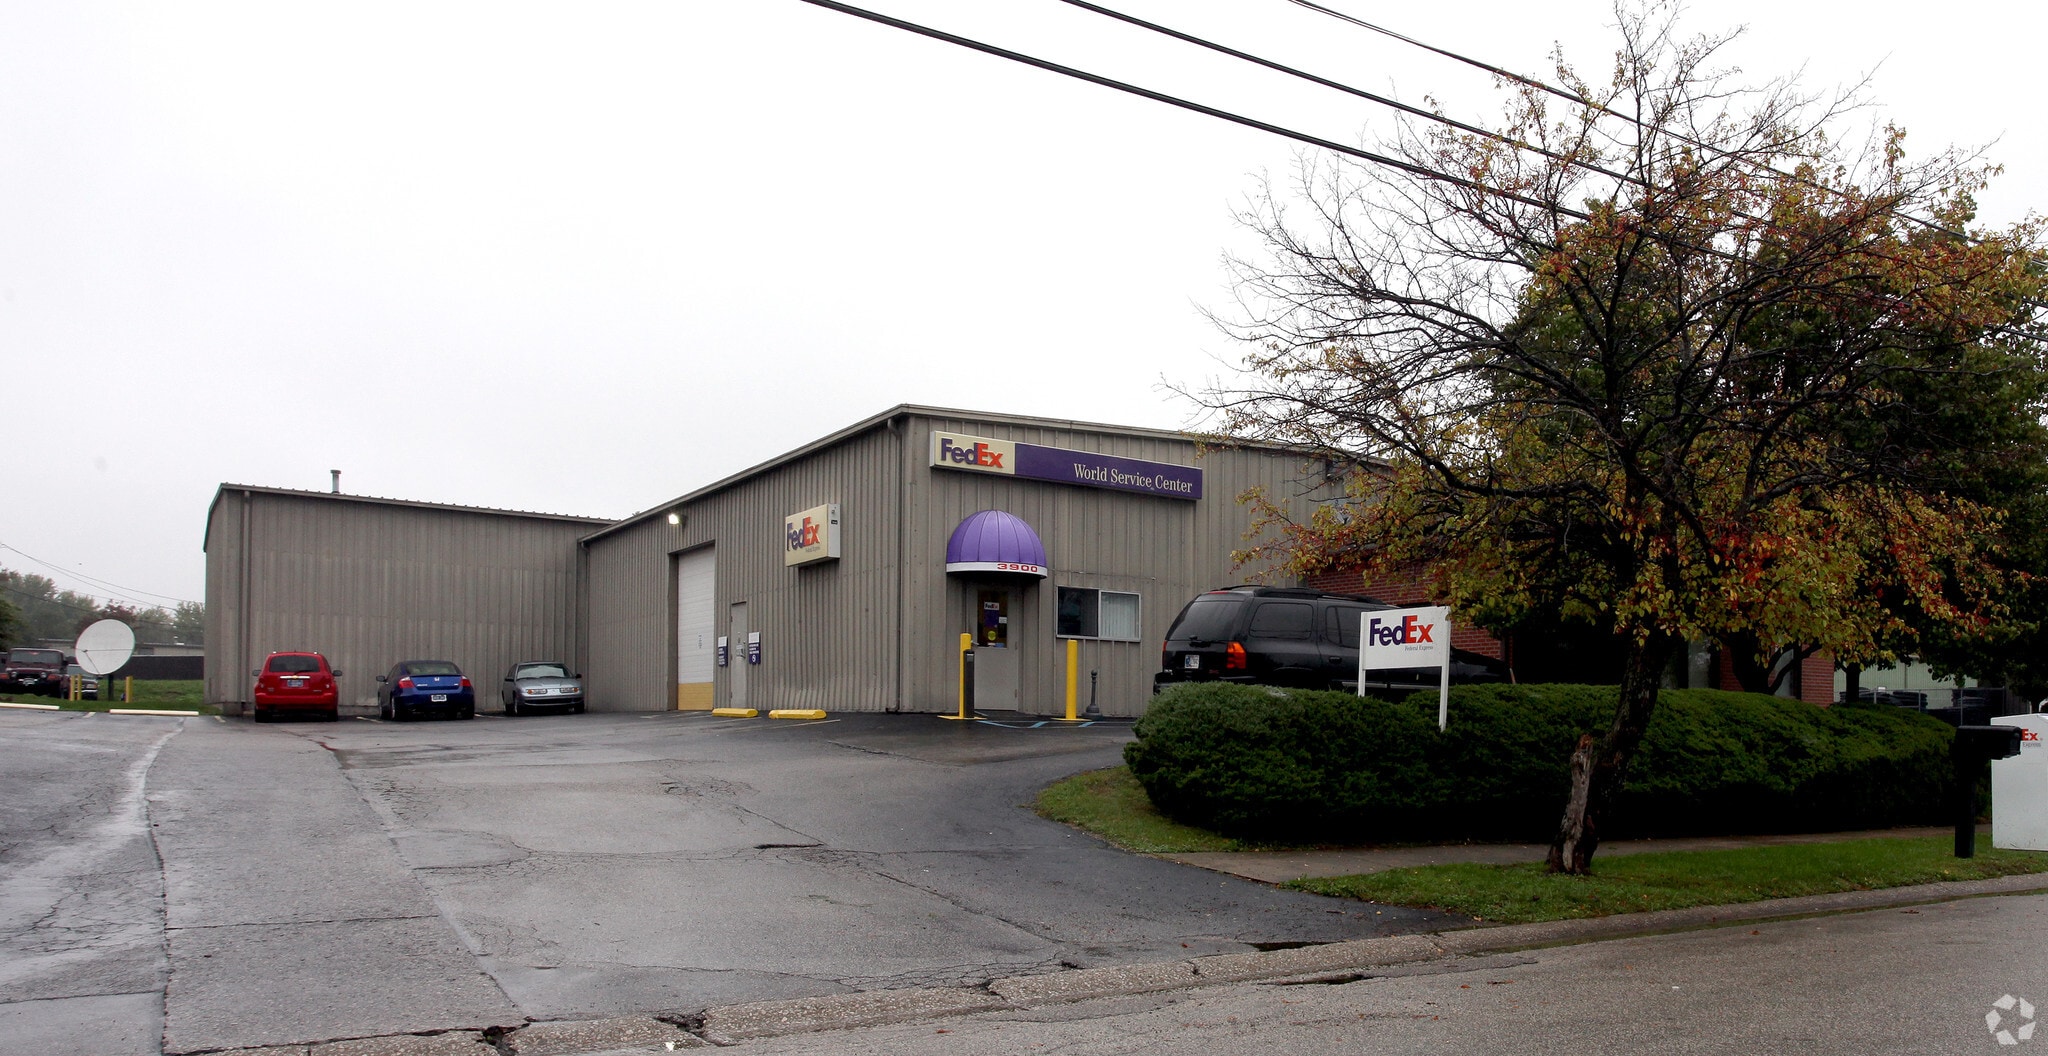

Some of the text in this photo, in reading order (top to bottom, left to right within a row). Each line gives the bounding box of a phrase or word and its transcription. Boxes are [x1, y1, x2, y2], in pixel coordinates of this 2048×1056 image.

[940, 437, 1004, 469] FedEx
[1073, 463, 1193, 493] World Service Center
[786, 516, 820, 552] FedEx
[997, 563, 1038, 573] 3900
[1369, 615, 1434, 646] FedEx
